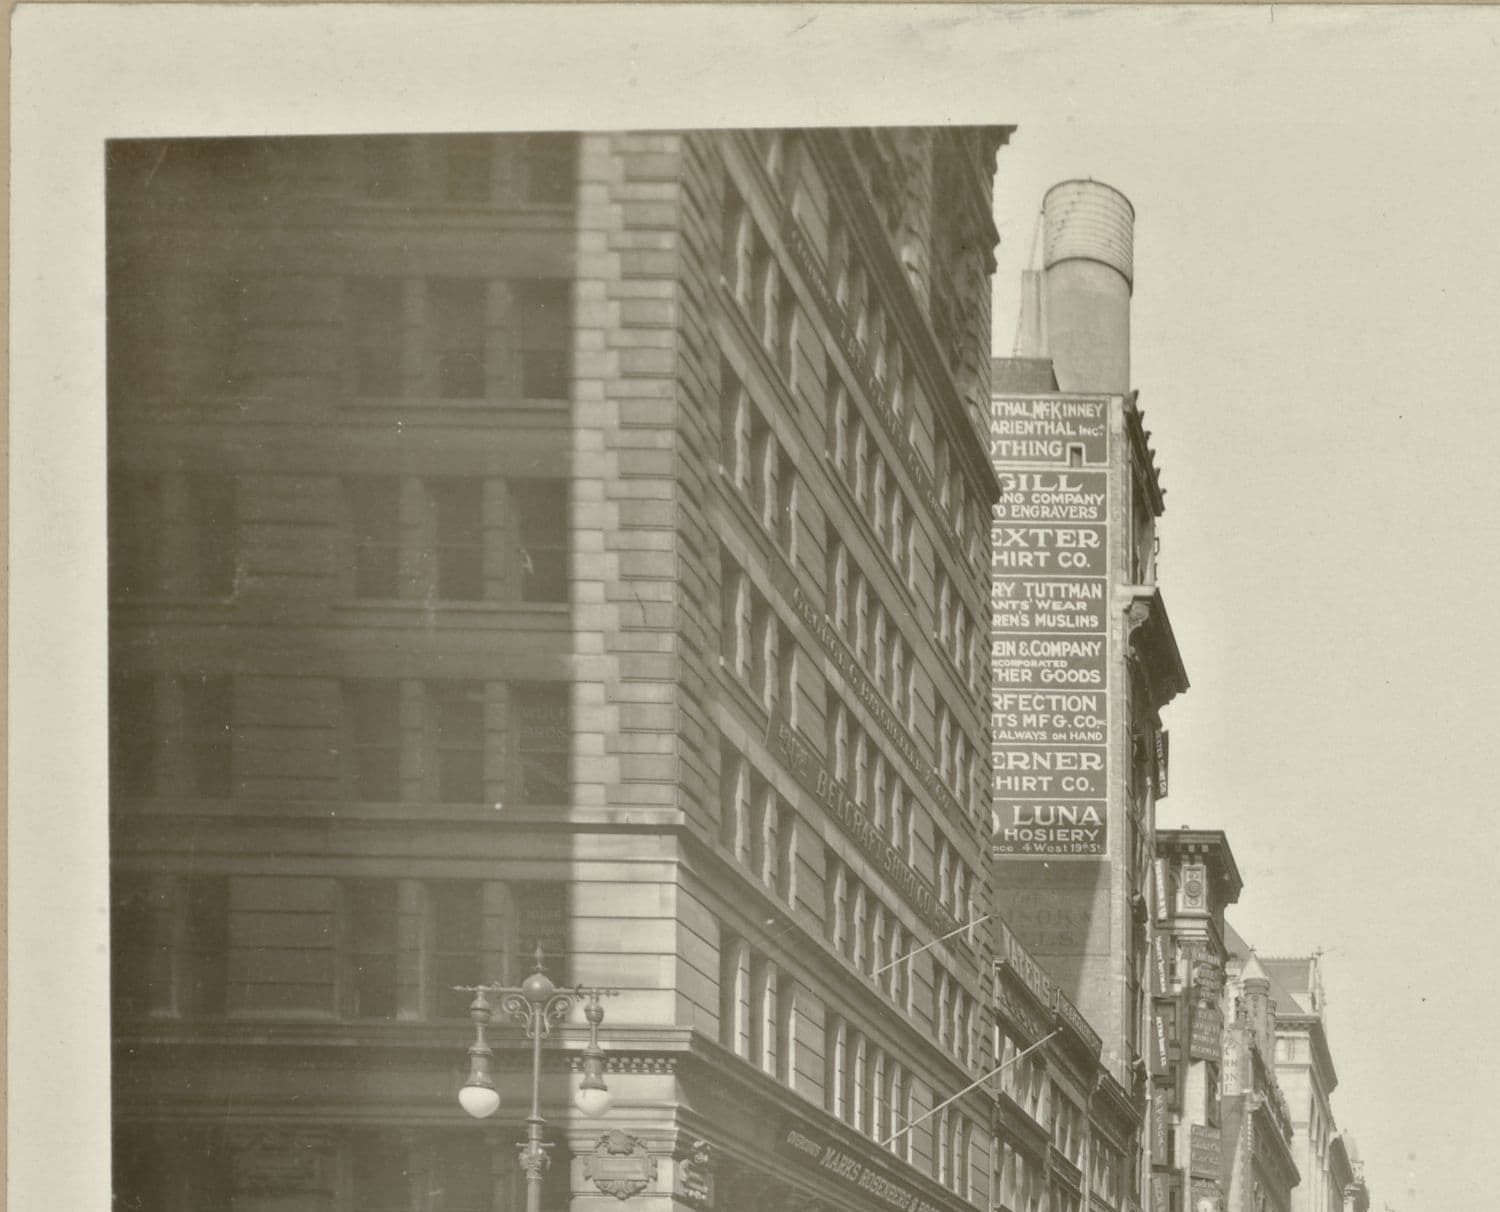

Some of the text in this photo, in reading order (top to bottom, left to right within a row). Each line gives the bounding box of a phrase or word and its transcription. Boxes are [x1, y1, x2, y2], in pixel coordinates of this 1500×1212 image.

[1031, 492, 1105, 505] COMPANY
[1011, 505, 1098, 519] ENGRAVERS
[1057, 551, 1091, 568] CO.
[1023, 581, 1102, 599] TUTTMAN
[1035, 599, 1088, 611] WEAR
[1034, 612, 1099, 628] MUSLINS
[1018, 640, 1031, 657] &
[1030, 639, 1102, 658] COMPANY
[1040, 668, 1101, 684] GOODS
[999, 730, 1047, 741] ALWAYS
[1069, 730, 1103, 741] HAND
[1062, 776, 1096, 792] CO.
[1013, 805, 1104, 826] LUNA
[1004, 828, 1099, 842] HOSIERY
[1022, 843, 1031, 853] 4
[1033, 842, 1067, 853] West
[819, 1146, 863, 1182] MARKS
